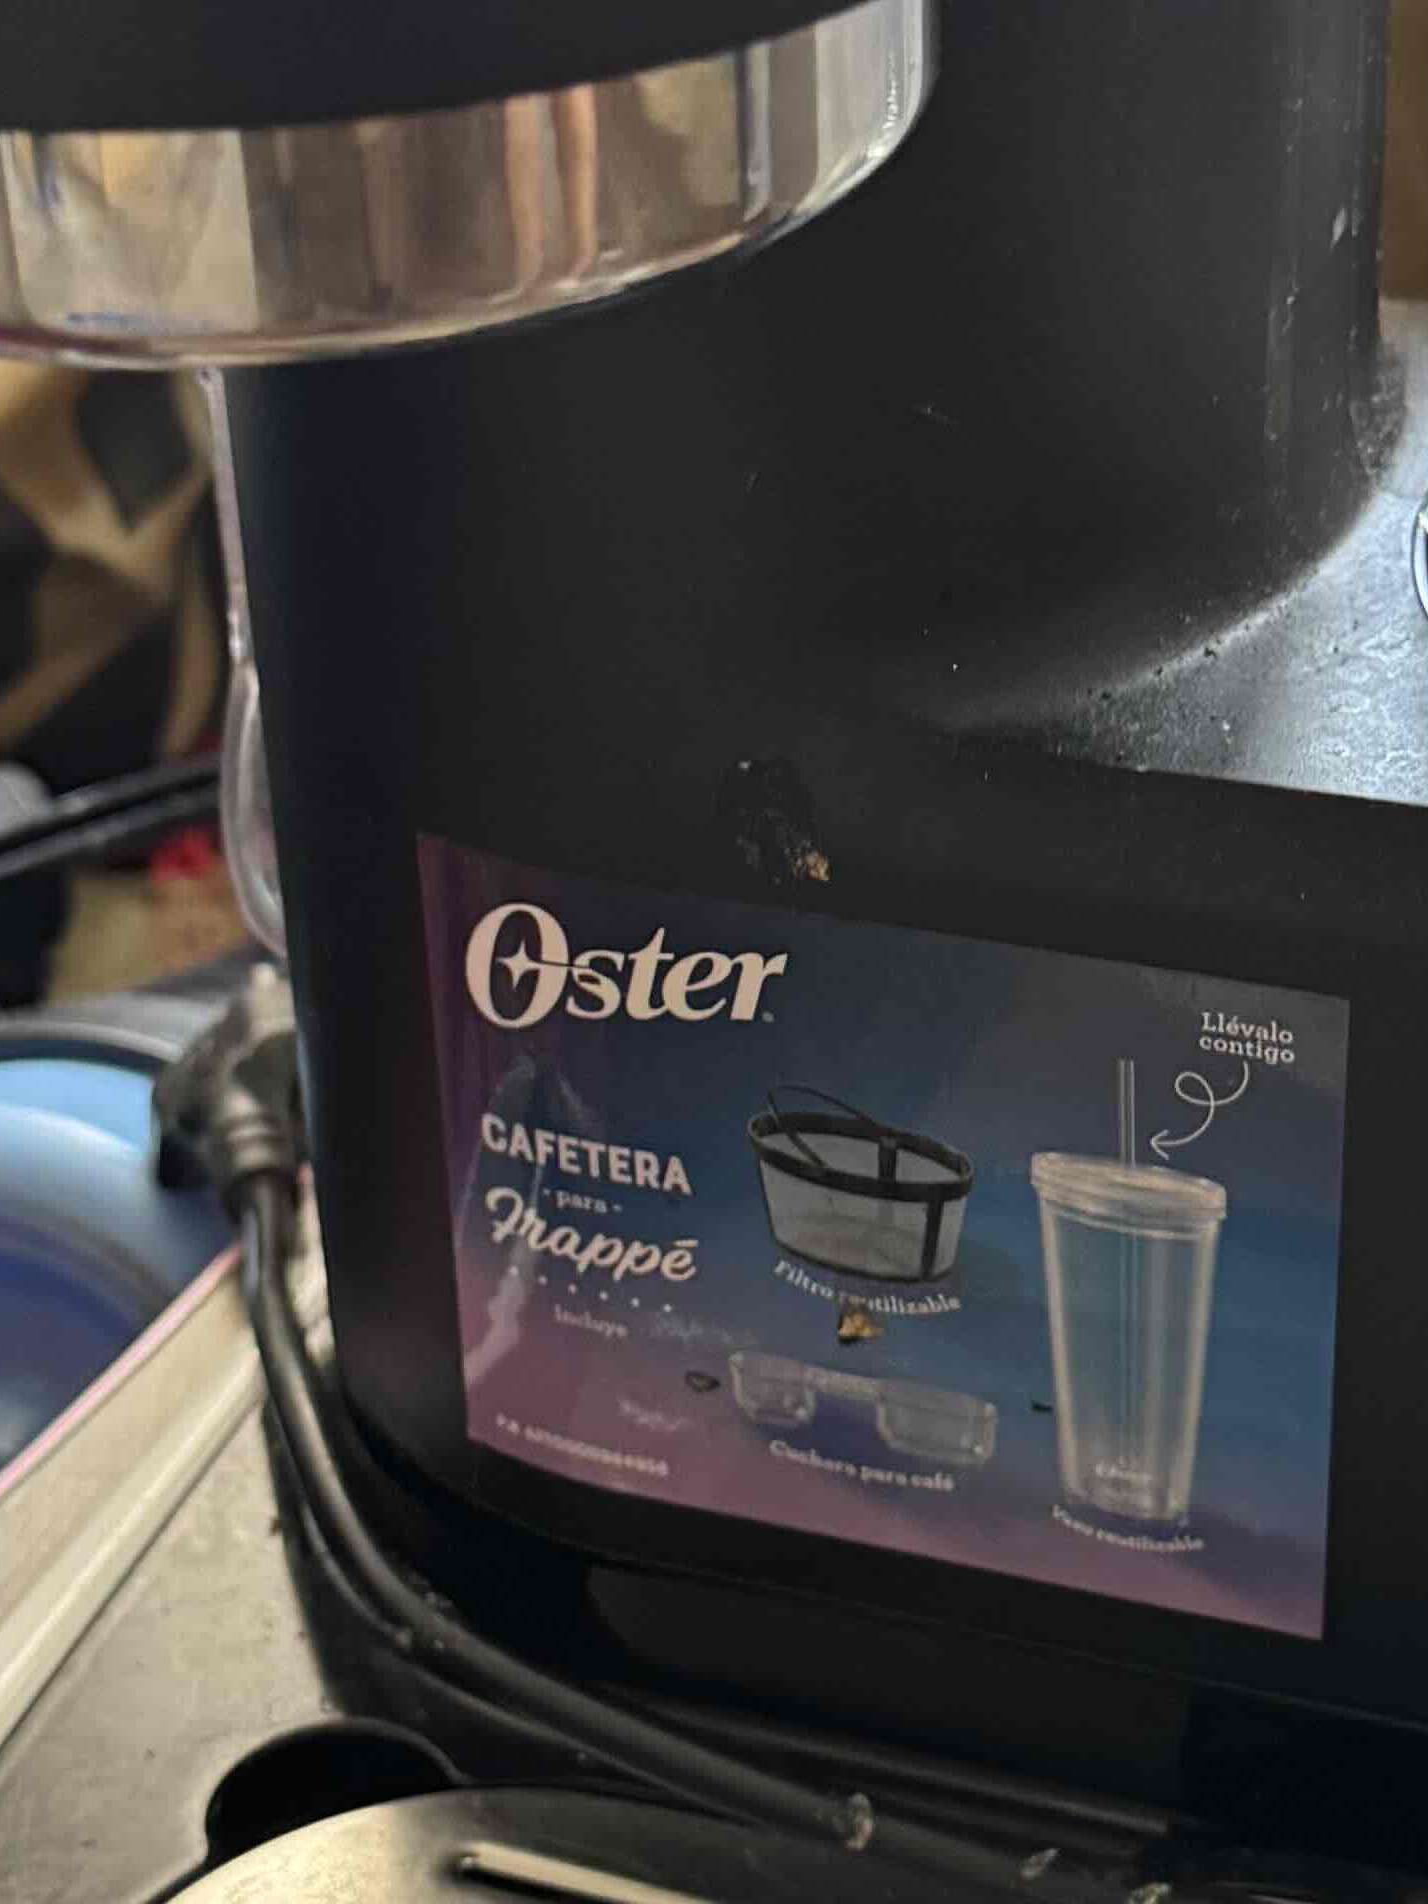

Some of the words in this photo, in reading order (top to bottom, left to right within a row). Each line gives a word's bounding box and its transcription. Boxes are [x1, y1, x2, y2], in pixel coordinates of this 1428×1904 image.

[466, 902, 789, 1029] Oster
[1200, 1011, 1294, 1045] Llévalo
[1199, 1035, 1295, 1065] contigo
[481, 1112, 693, 1195] CAFETERA
[774, 1259, 834, 1299] Filtro
